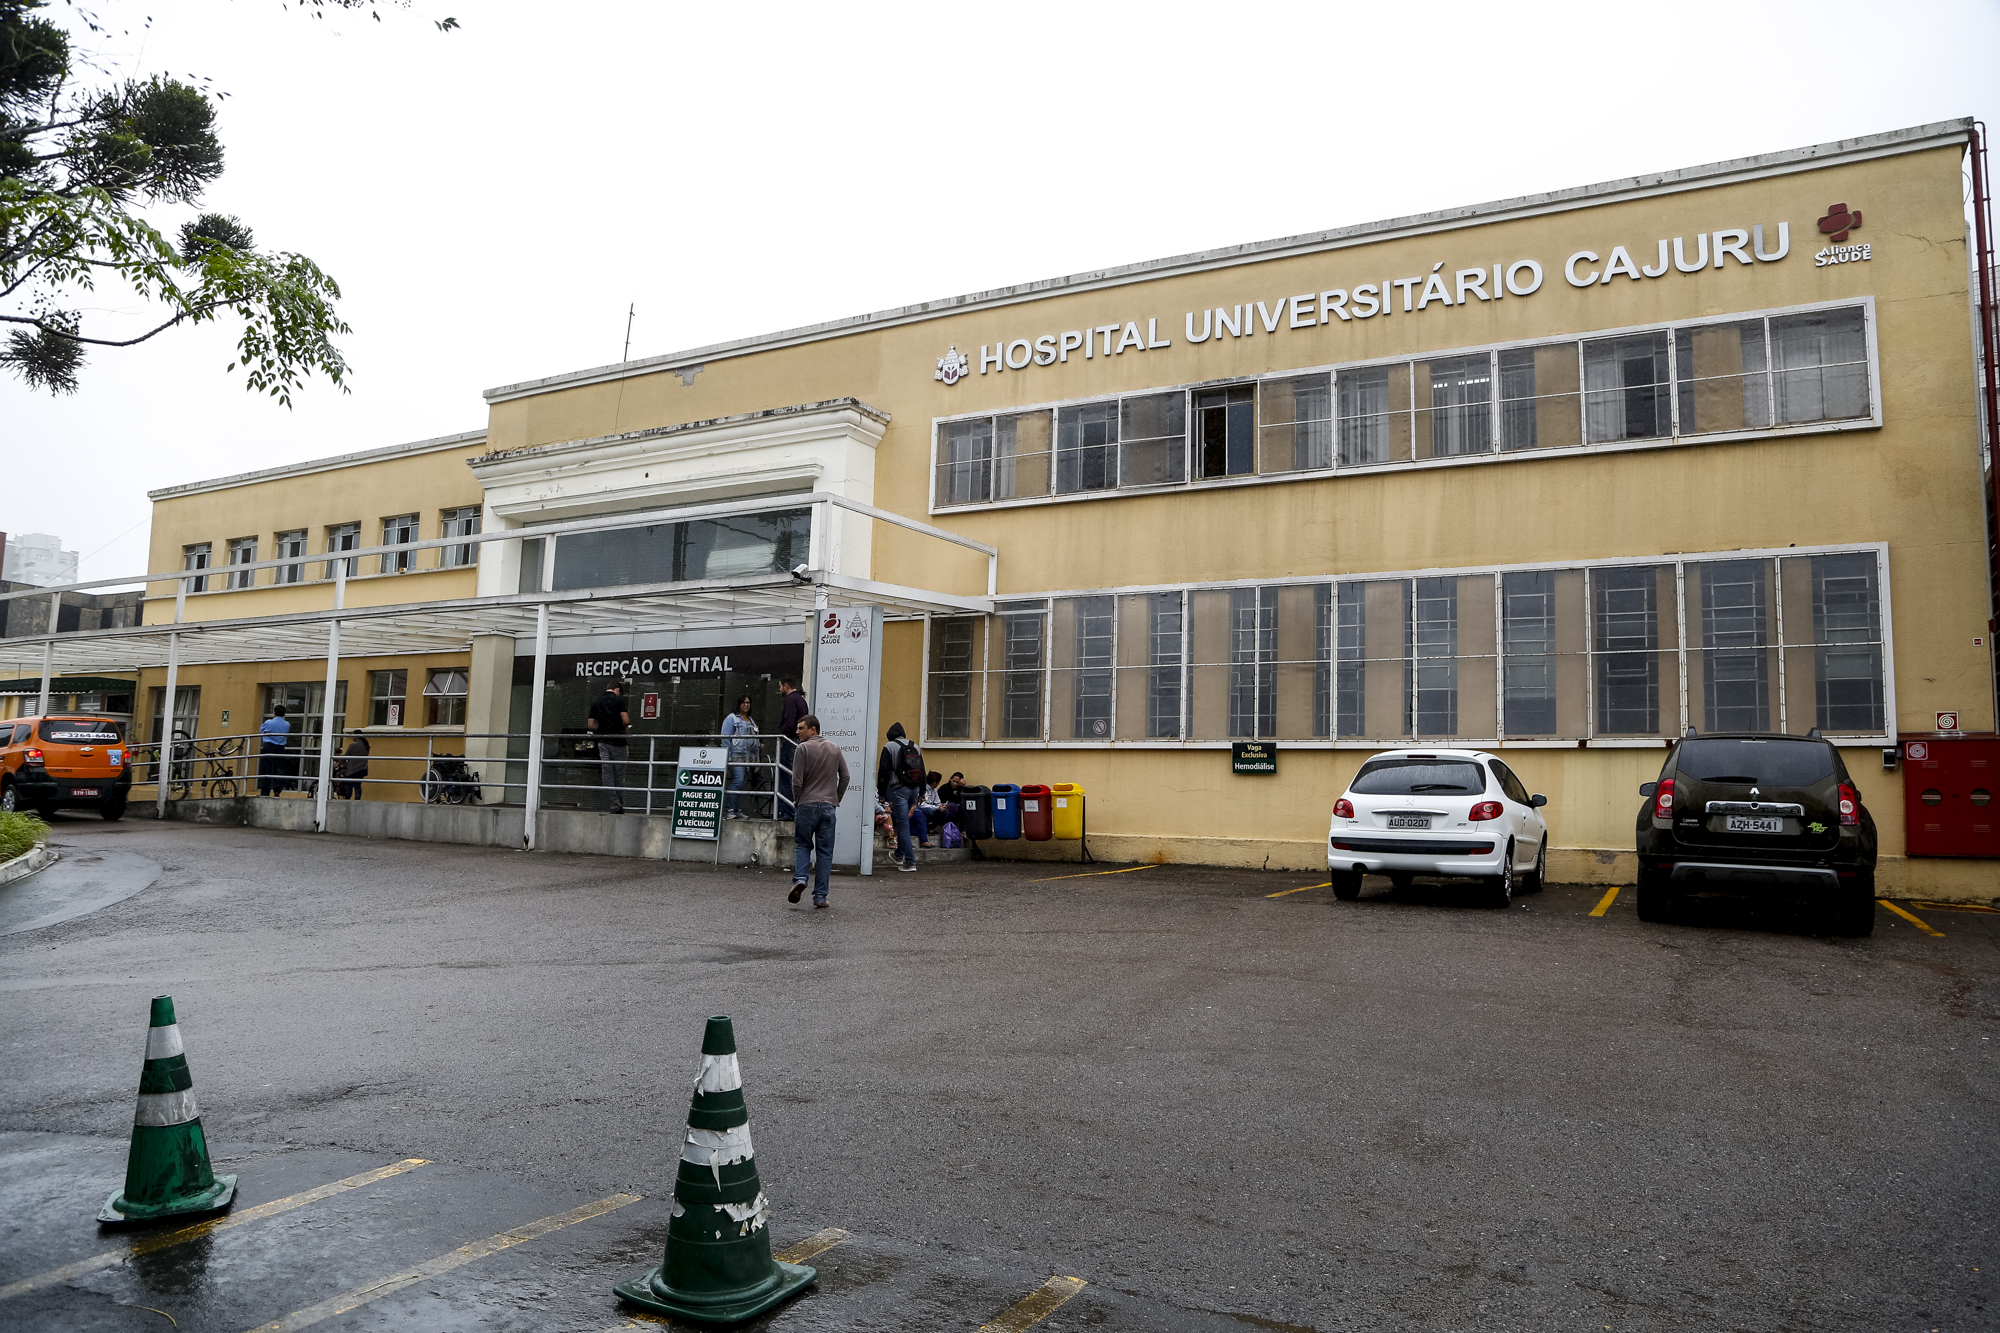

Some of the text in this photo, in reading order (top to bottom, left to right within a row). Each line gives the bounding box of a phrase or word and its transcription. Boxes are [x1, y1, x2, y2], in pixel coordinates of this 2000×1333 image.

[1814, 249, 1872, 268] SAÚDE
[980, 221, 1790, 376] HOSPITAL UNIVERSITÁRIO CAJURU
[575, 655, 733, 679] RECEPÇÃO CENTRAL
[826, 691, 855, 699] RECEPÇÃO
[821, 729, 857, 737] EMERGÊNCIA
[1246, 744, 1262, 752] Vaga
[1234, 762, 1275, 770] Hemodiálise
[691, 771, 722, 785] SAÍDA
[682, 791, 703, 799] PAGUE
[677, 800, 719, 809] TICKET ANTES
[679, 809, 715, 818] DE RETIRAR
[684, 818, 715, 827] VEÍCULO!!
[1730, 820, 1777, 831] AZH-5441
